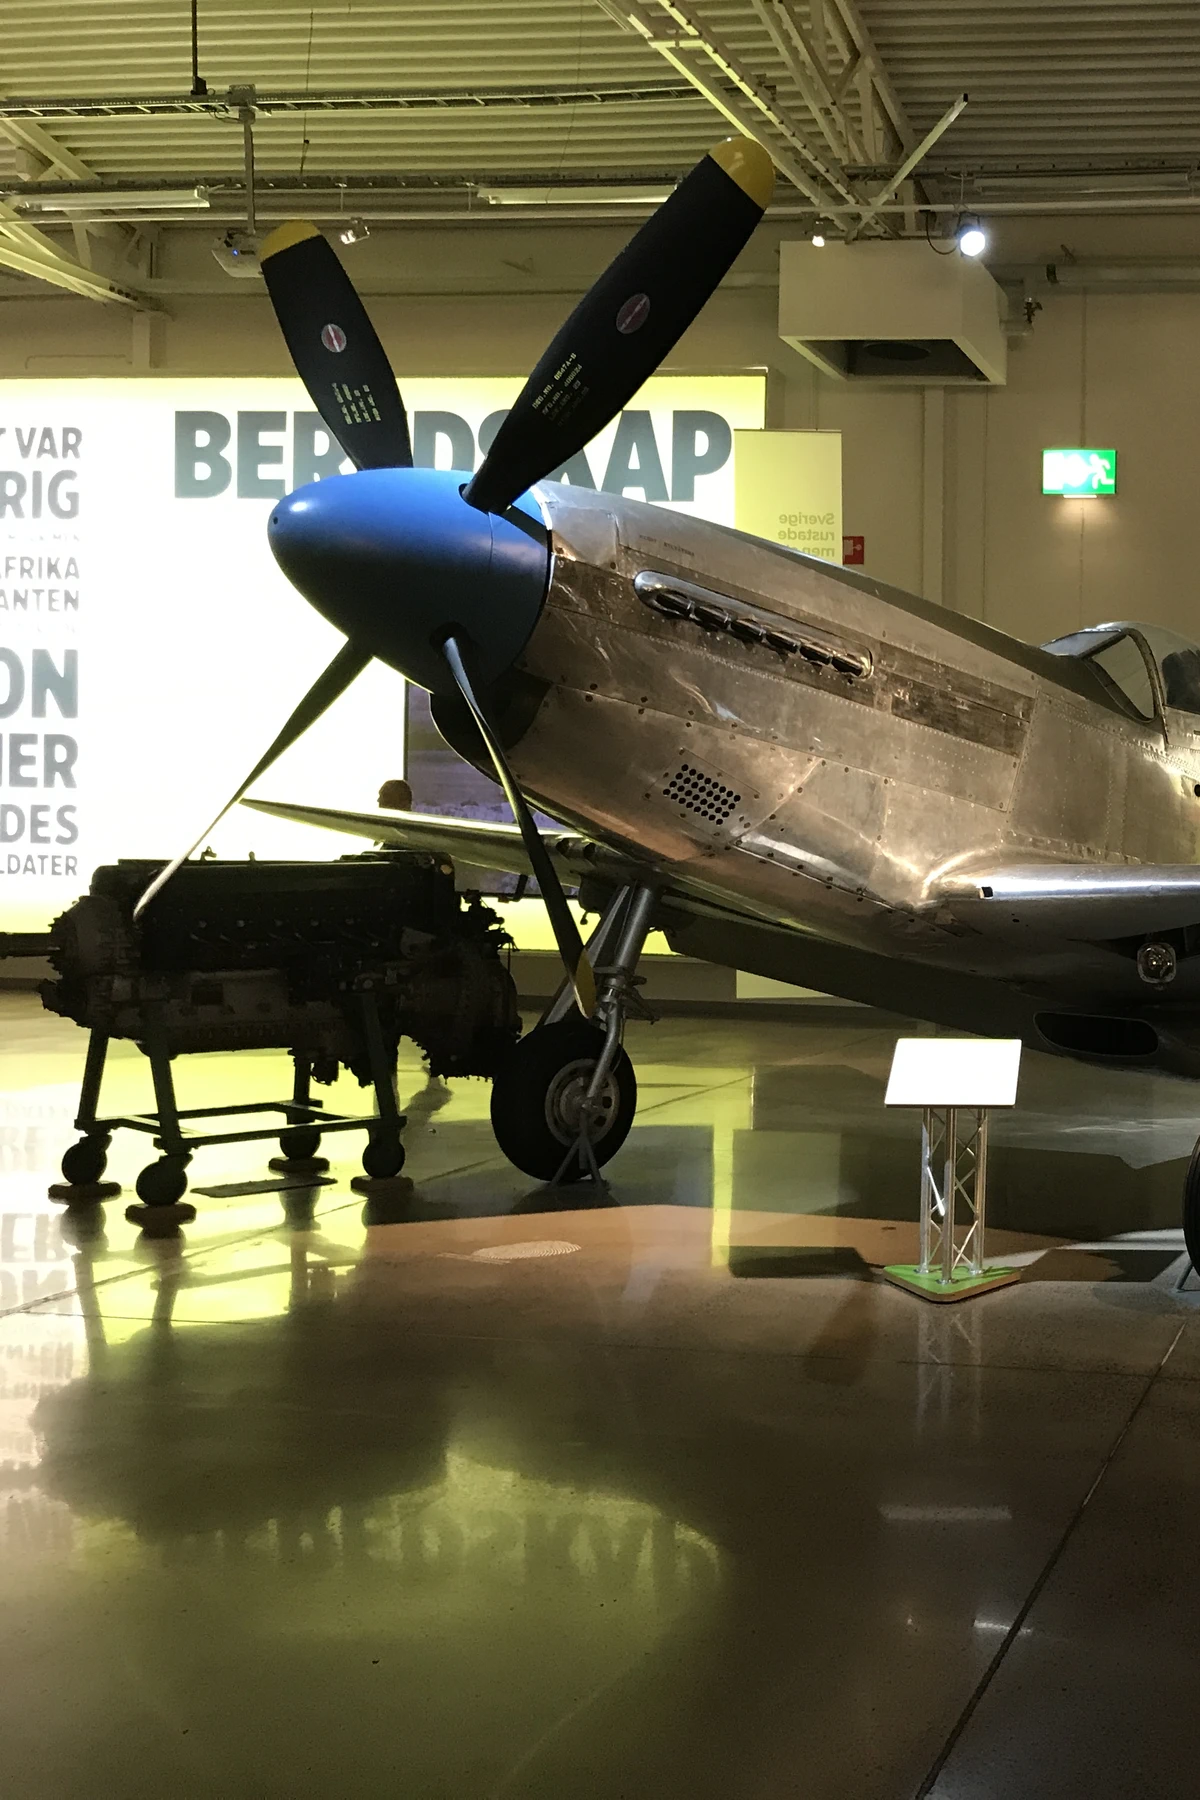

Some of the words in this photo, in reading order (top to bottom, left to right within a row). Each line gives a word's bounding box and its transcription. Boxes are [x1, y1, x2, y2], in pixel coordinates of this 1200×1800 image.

[15, 427, 83, 460] VAR
[174, 410, 732, 502] BERDAP
[0, 556, 80, 580] FRIKA
[0, 803, 79, 846] DES
